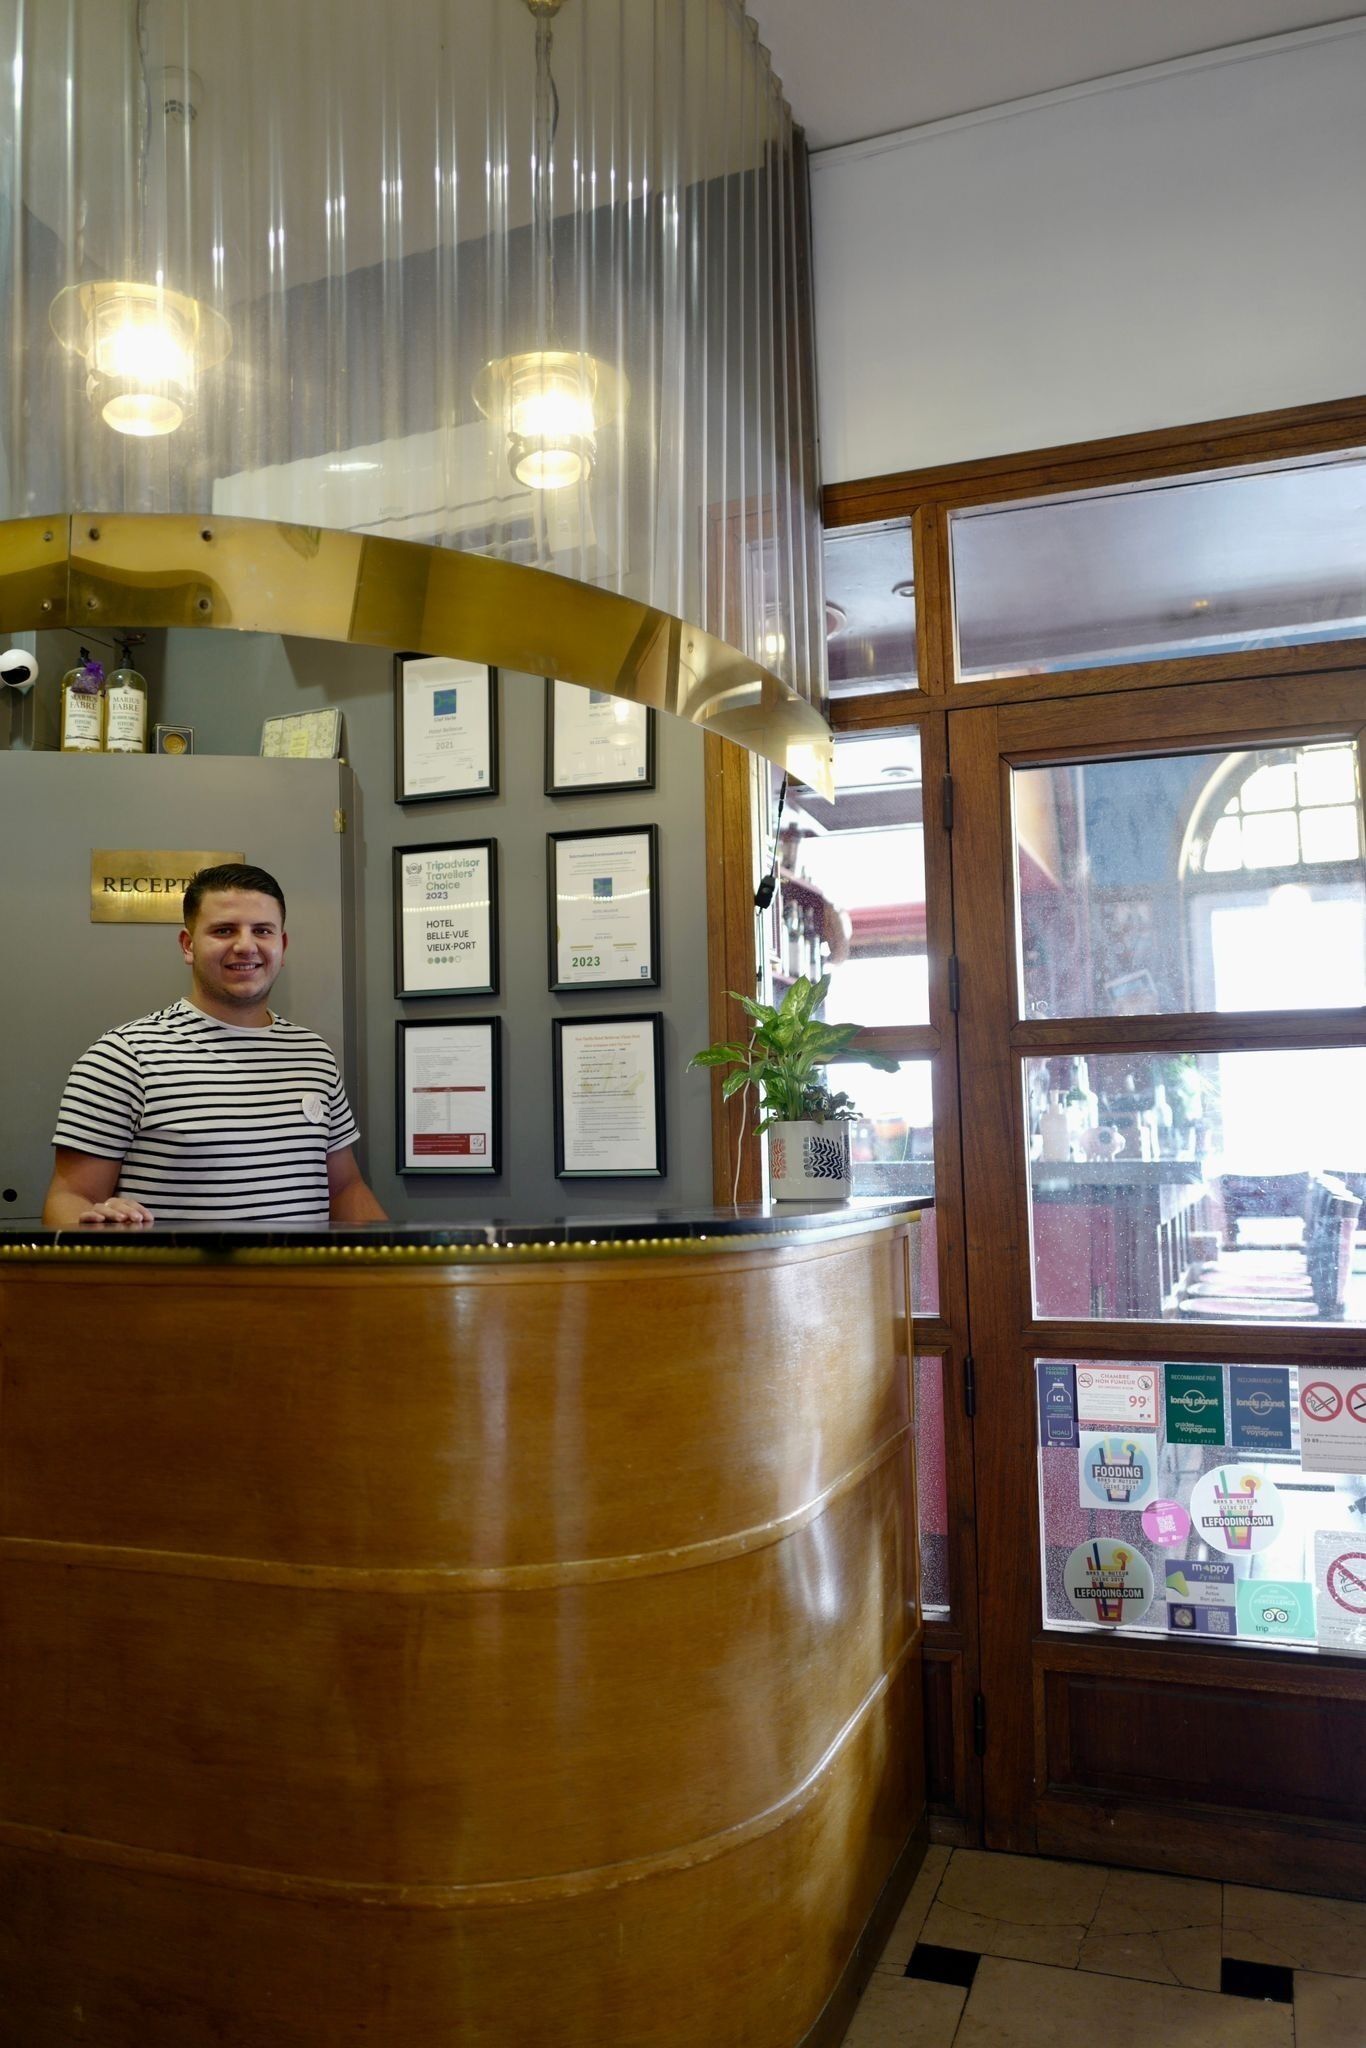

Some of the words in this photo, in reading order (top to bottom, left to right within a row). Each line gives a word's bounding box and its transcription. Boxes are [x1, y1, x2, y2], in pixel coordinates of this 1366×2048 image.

[113, 696, 140, 704] MARIUS
[70, 701, 97, 711] FABRE
[112, 703, 139, 712] FABRE
[436, 741, 454, 750] 2021
[425, 858, 480, 872] Tripadvisor
[426, 868, 476, 881] Travellers'
[102, 877, 191, 894] RECEPT
[426, 881, 461, 891] Choice
[426, 891, 448, 900] 2023
[426, 919, 454, 929] HOTEL
[426, 930, 469, 940] BELLE-VUE
[427, 941, 477, 952] VIEUX-PORT
[572, 956, 601, 968] 2023
[1170, 1395, 1193, 1407] lonely
[1194, 1396, 1218, 1407] planet
[1236, 1398, 1259, 1409] lonely
[1260, 1399, 1285, 1409] planet
[1180, 1426, 1216, 1434] voyageurs
[1094, 1466, 1141, 1478] FOODING
[1203, 1516, 1272, 1527] LEFOODING.COM
[1076, 1588, 1142, 1598] LEFOODING.COM
